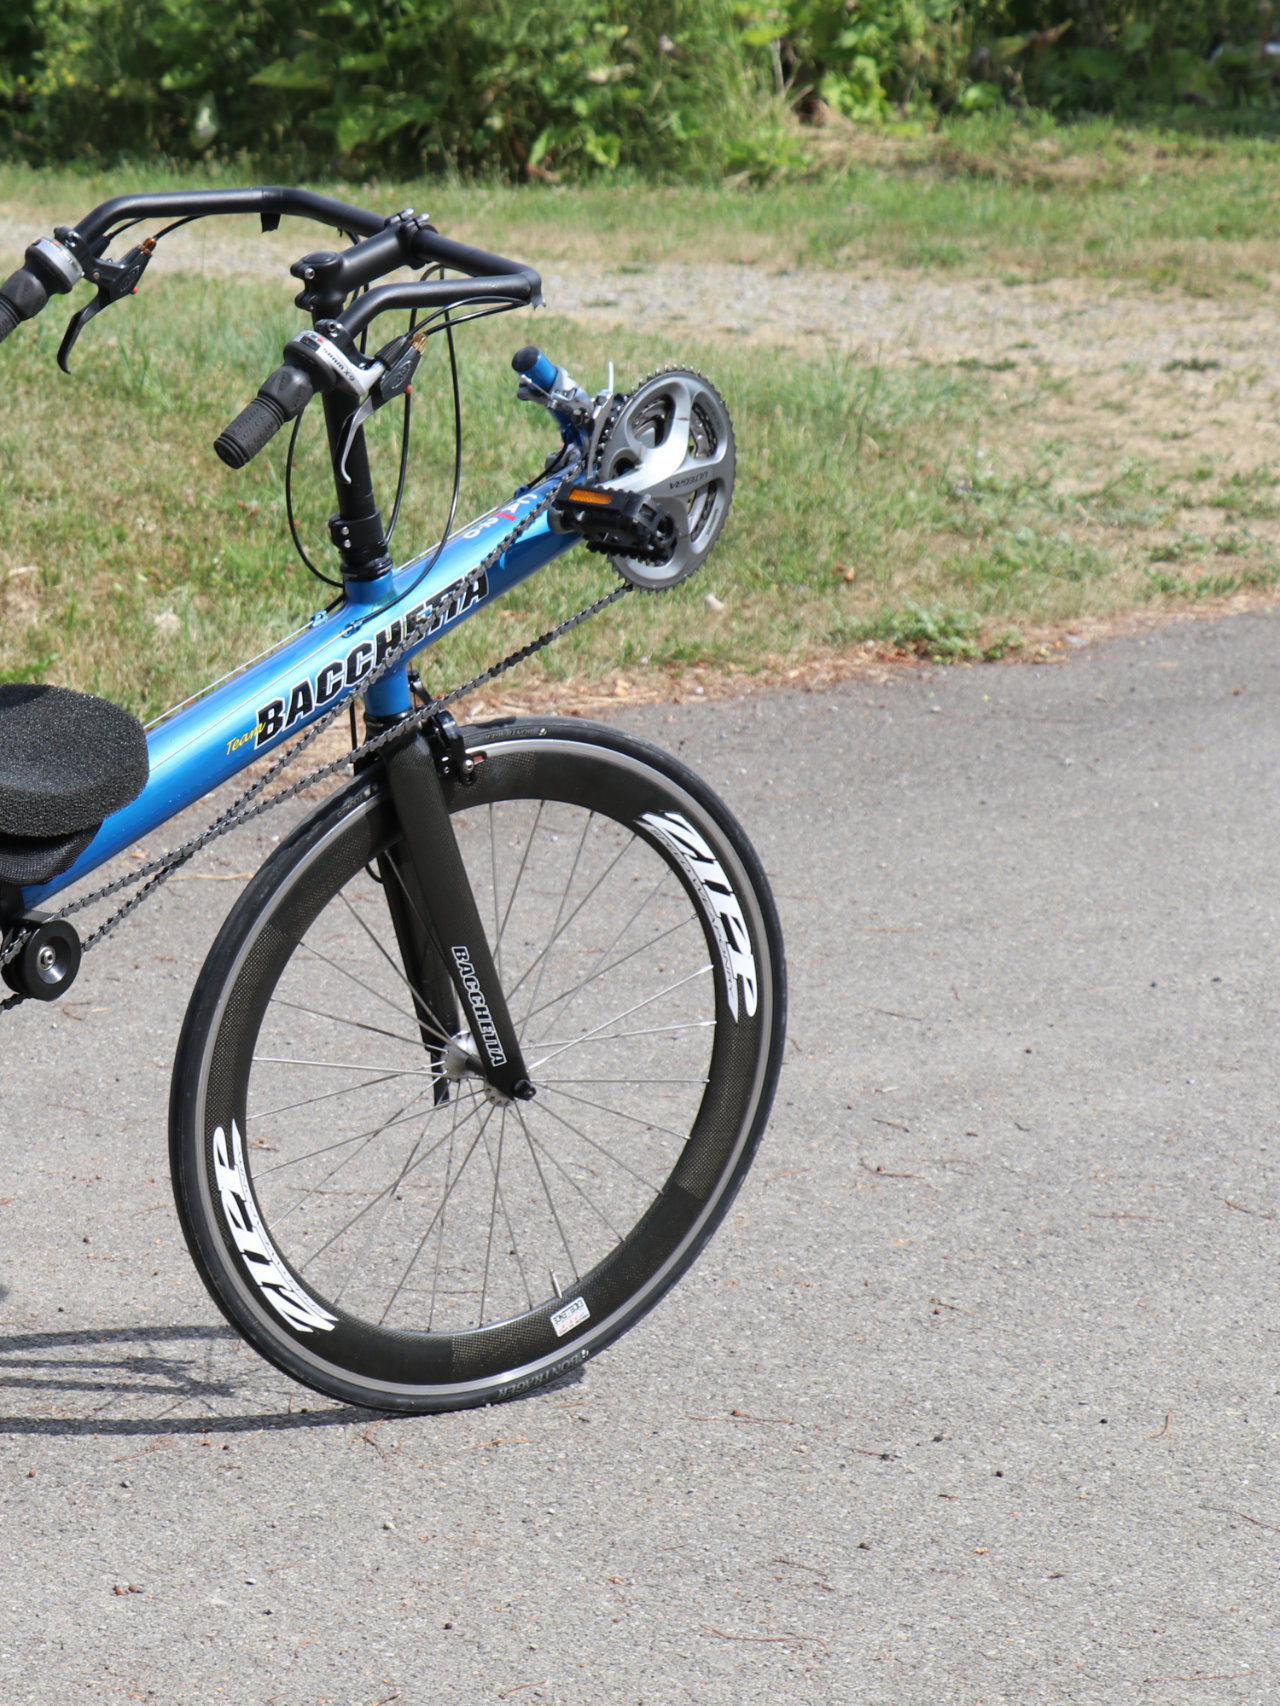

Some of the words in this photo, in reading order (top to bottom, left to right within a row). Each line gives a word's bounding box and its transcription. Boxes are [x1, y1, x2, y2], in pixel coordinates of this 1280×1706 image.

[225, 721, 266, 756] Team
[254, 567, 490, 750] BACCHETTA
[451, 946, 508, 1067] BACCHETTA
[639, 811, 758, 1018] ZIPP
[212, 1125, 336, 1333] ZIPP
